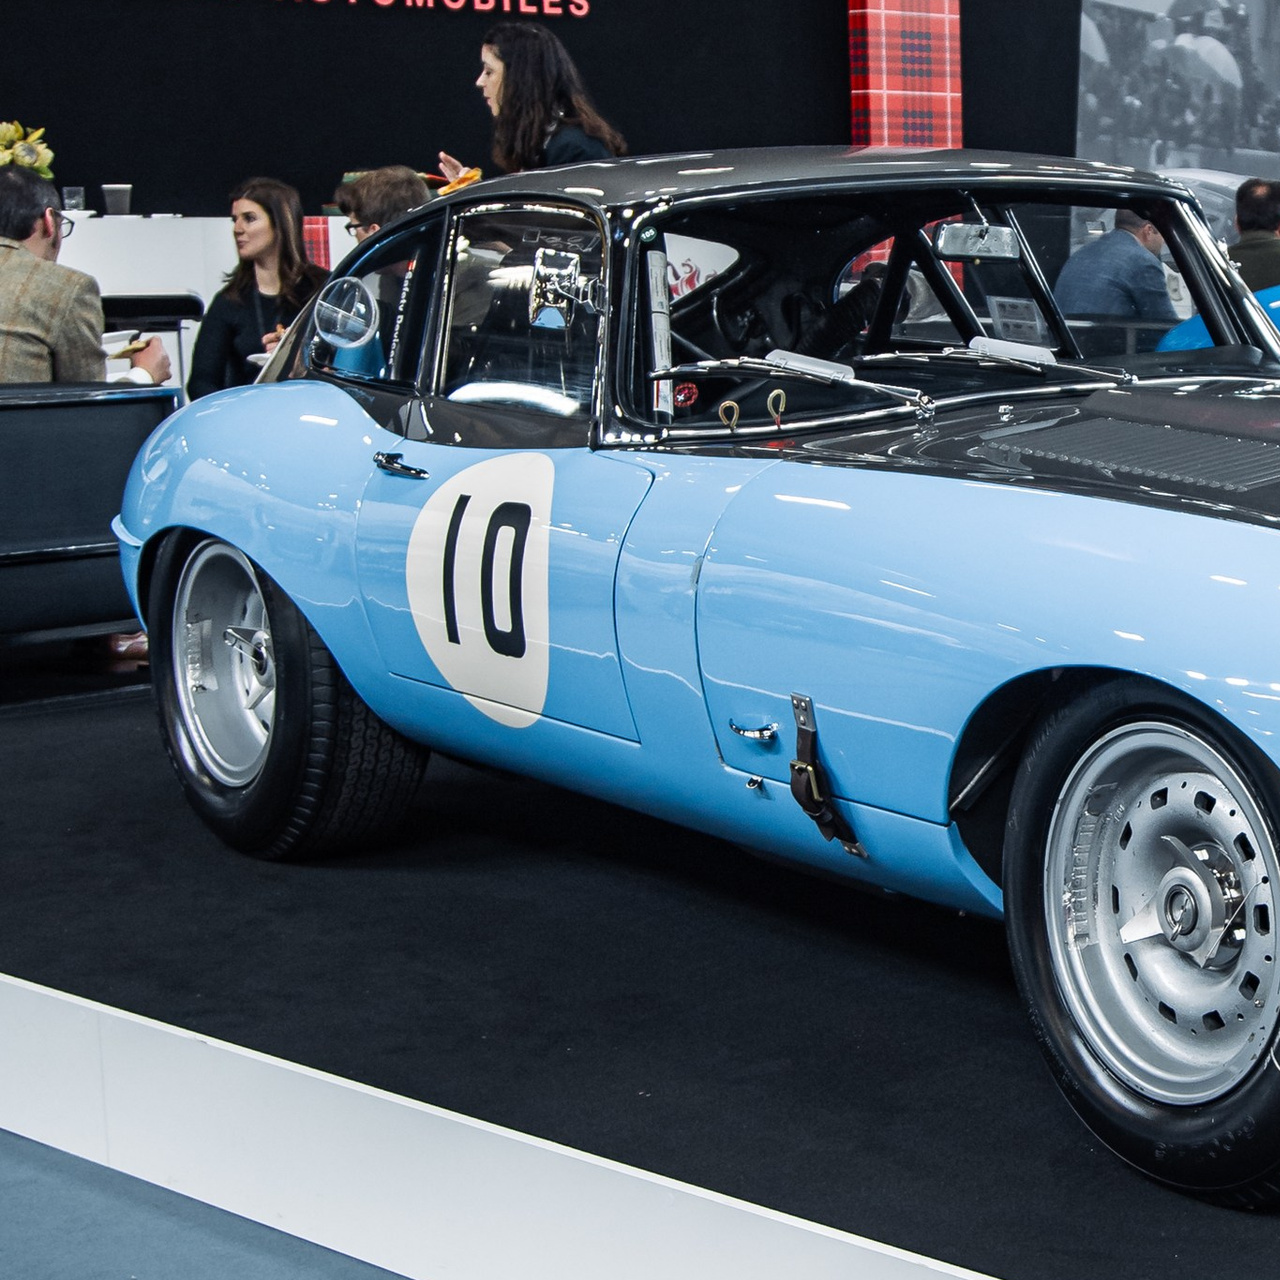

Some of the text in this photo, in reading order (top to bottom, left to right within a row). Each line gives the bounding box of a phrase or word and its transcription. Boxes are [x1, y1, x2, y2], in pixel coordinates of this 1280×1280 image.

[641, 228, 656, 241] 105
[398, 271, 413, 312] Safety
[441, 493, 533, 659] 10
